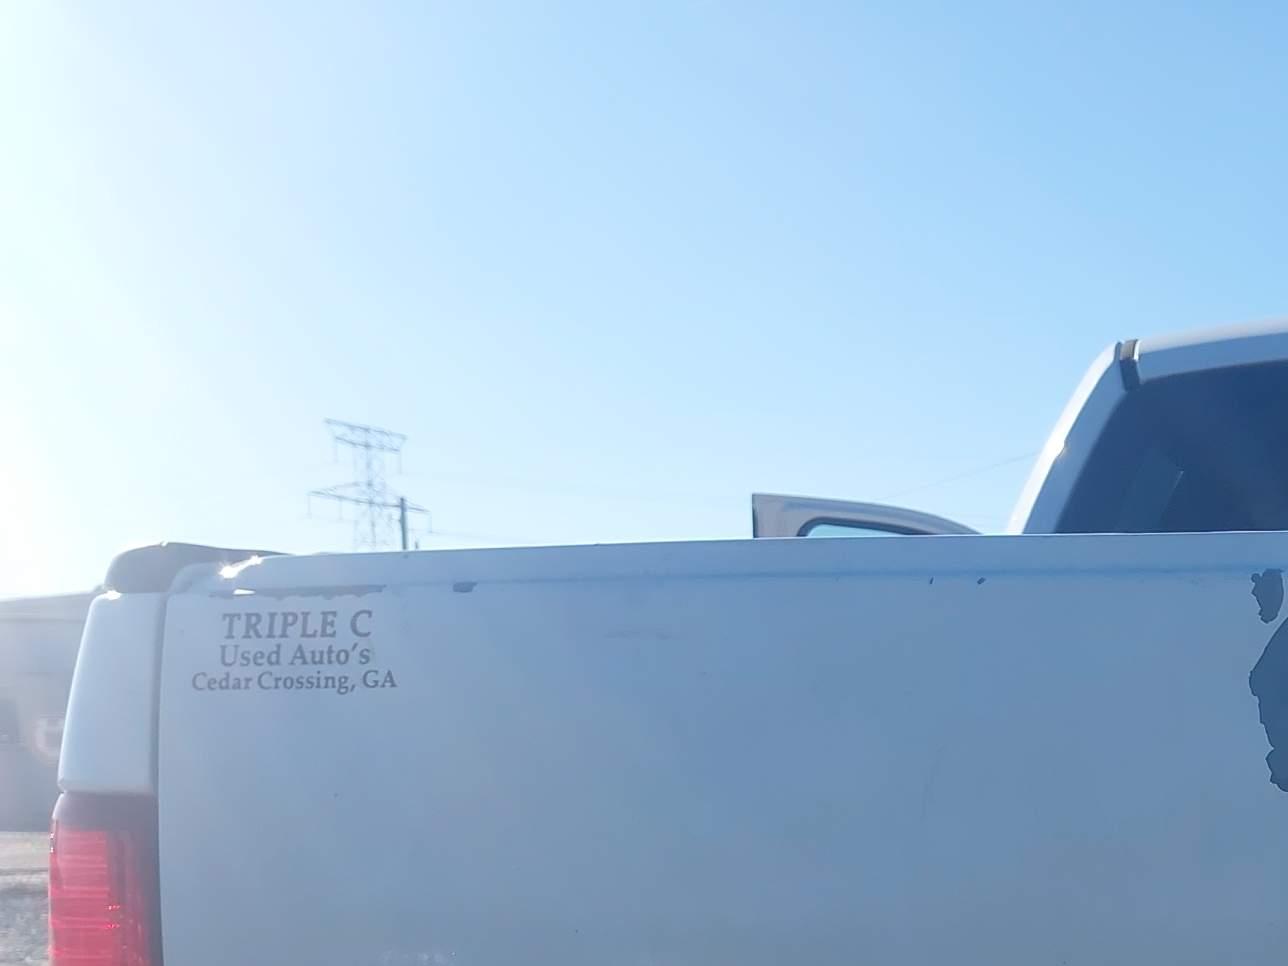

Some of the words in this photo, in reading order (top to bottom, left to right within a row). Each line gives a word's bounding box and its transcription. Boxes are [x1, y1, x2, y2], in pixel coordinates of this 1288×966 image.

[222, 611, 337, 639] TRIPLE
[350, 610, 373, 637] C
[219, 643, 282, 667] Used
[288, 643, 371, 666] Auto's
[191, 672, 253, 691] Cedar
[257, 671, 356, 695] Crossing,
[362, 670, 397, 688] GA
